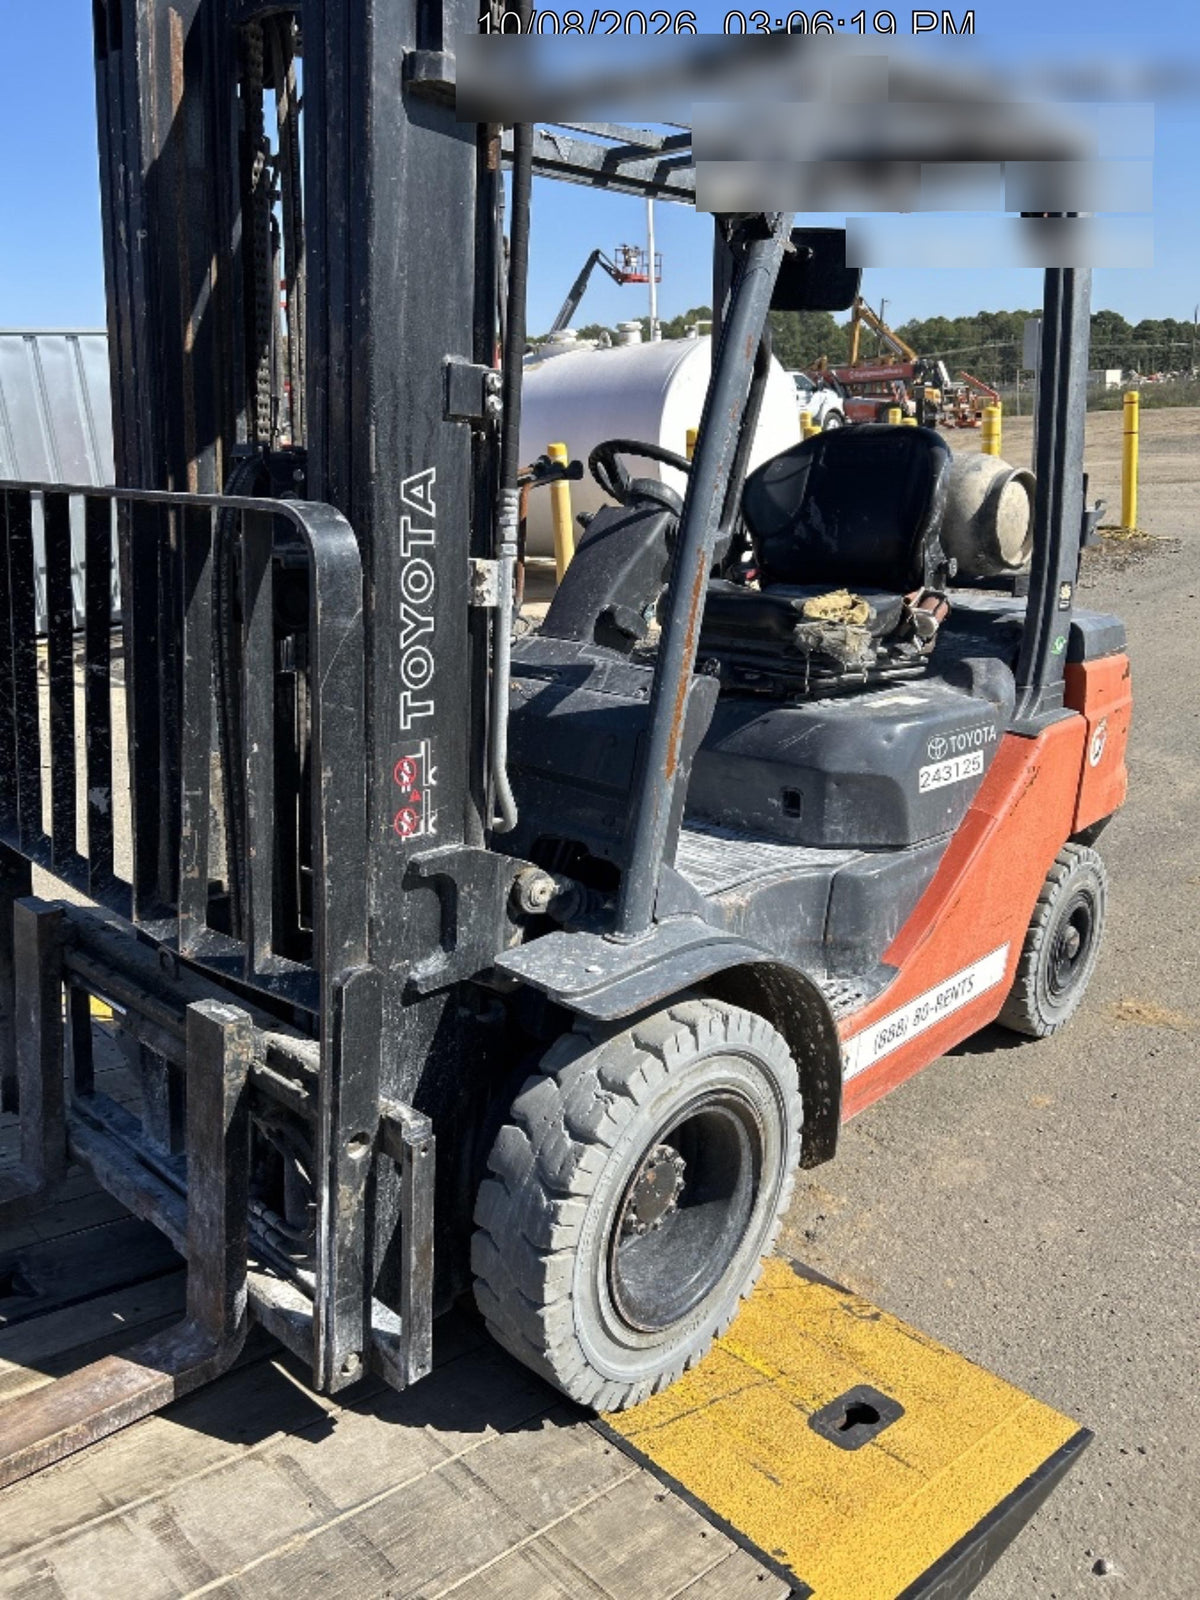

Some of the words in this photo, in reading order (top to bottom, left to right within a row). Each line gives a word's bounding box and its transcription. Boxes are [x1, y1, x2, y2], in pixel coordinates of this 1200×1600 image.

[399, 467, 437, 731] TOYOTA
[948, 726, 997, 753] TOYOTA
[920, 757, 981, 789] 243125
